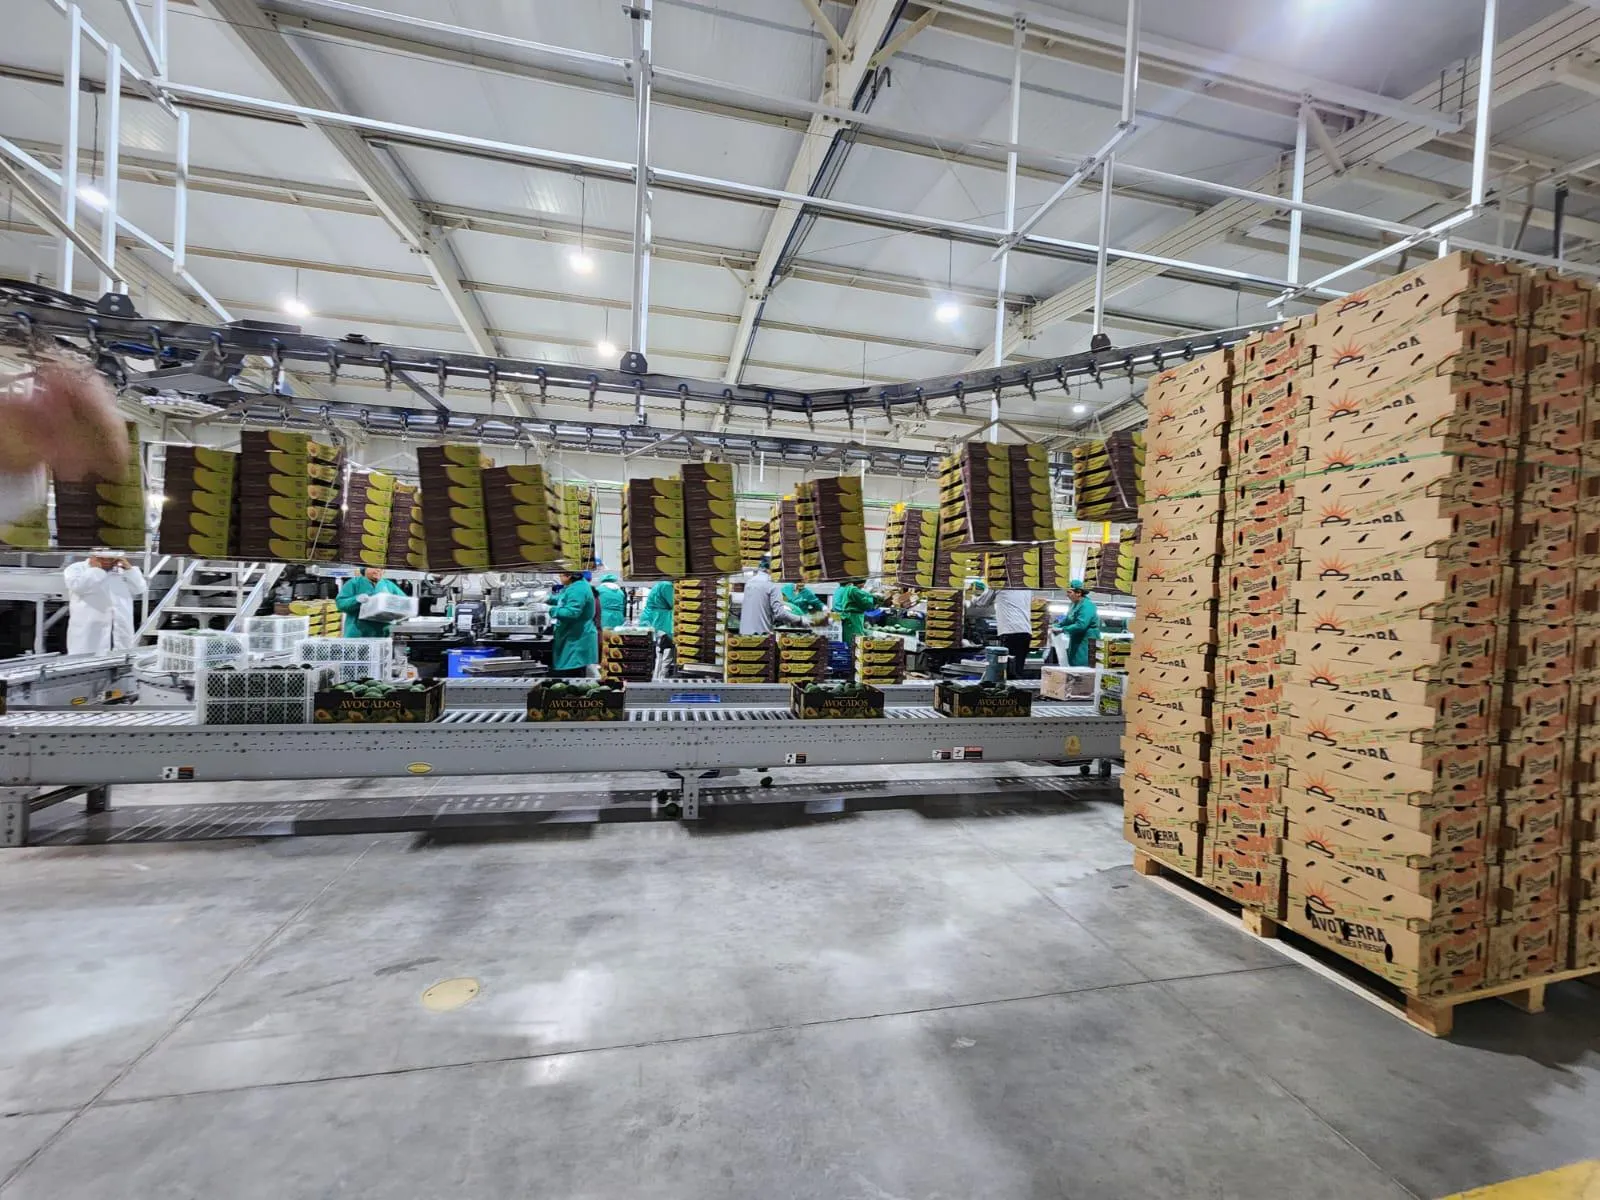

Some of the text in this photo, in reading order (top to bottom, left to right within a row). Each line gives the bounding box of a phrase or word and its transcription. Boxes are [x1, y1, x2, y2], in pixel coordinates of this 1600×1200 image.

[339, 699, 401, 709] AVOCADOS
[549, 700, 604, 708] AVOCADOS
[822, 699, 868, 707] AVOCADOS
[976, 696, 1018, 706] AVOCADOS
